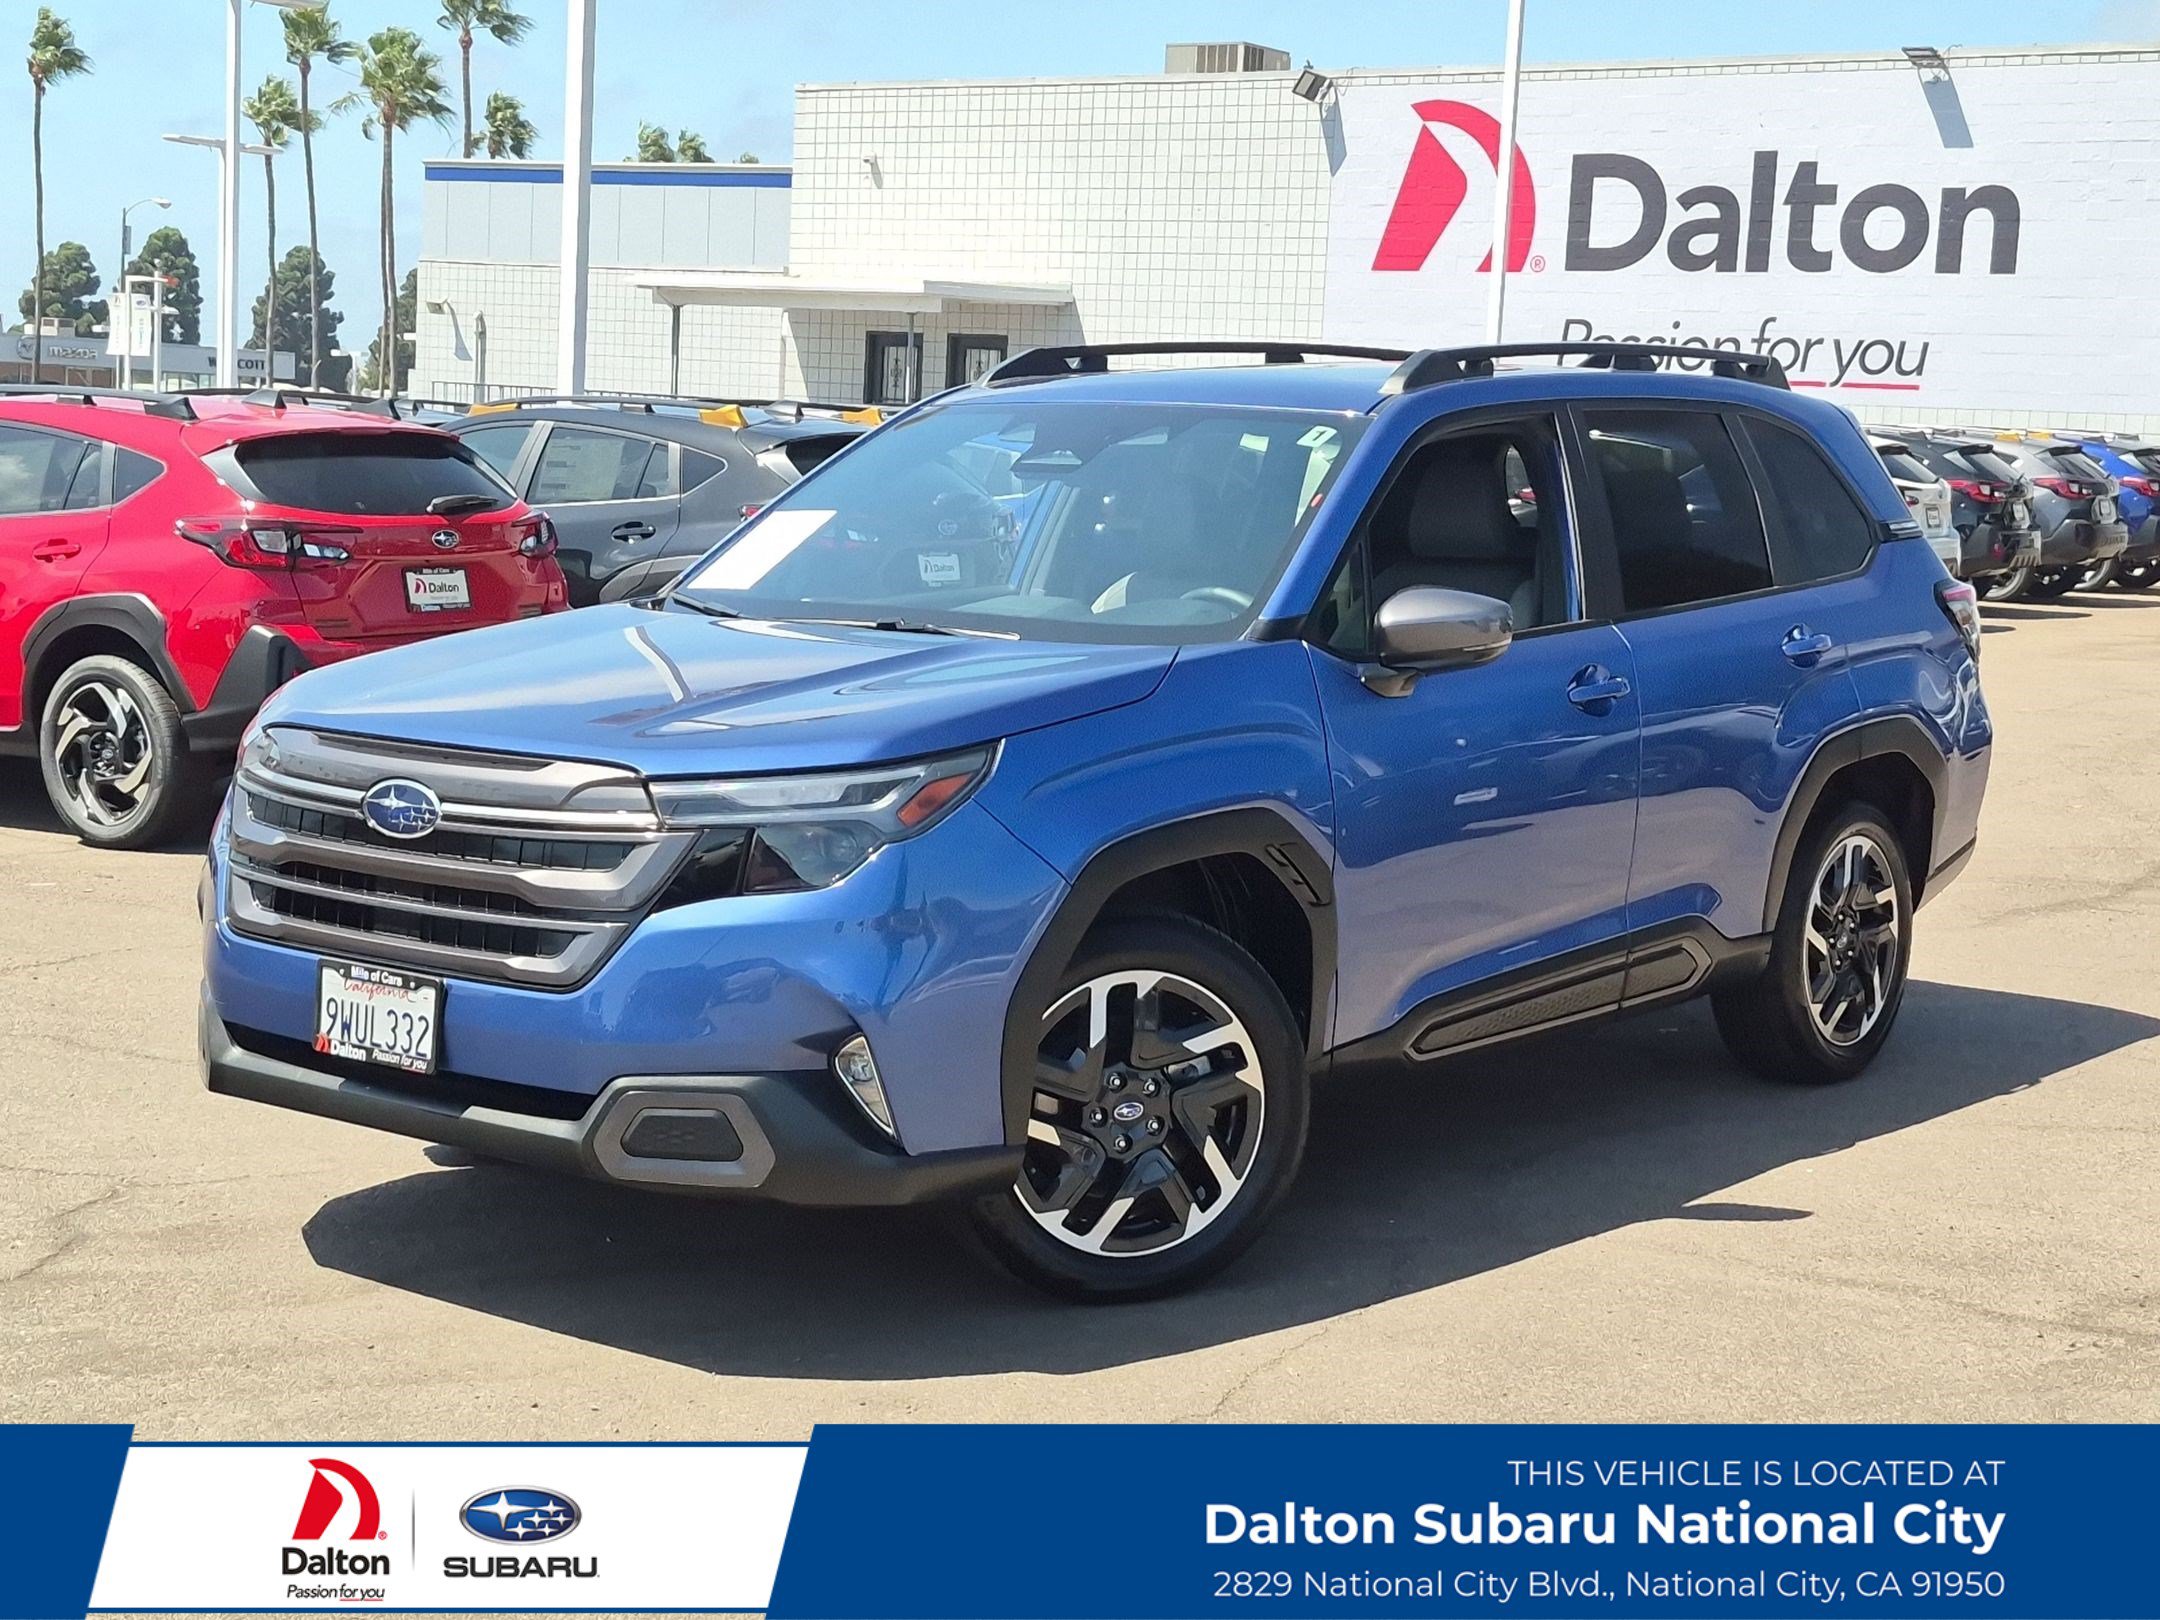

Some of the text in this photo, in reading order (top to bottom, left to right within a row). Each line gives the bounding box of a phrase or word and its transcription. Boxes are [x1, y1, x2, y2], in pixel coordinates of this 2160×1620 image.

[1564, 151, 2021, 275] Dalton
[49, 346, 98, 359] mazda
[1829, 338, 1930, 388] you
[428, 581, 460, 593] Dalton
[351, 965, 403, 987] Mile of Cars
[326, 997, 430, 1059] 9WUL332
[330, 1040, 428, 1070] Dalton Passion for you
